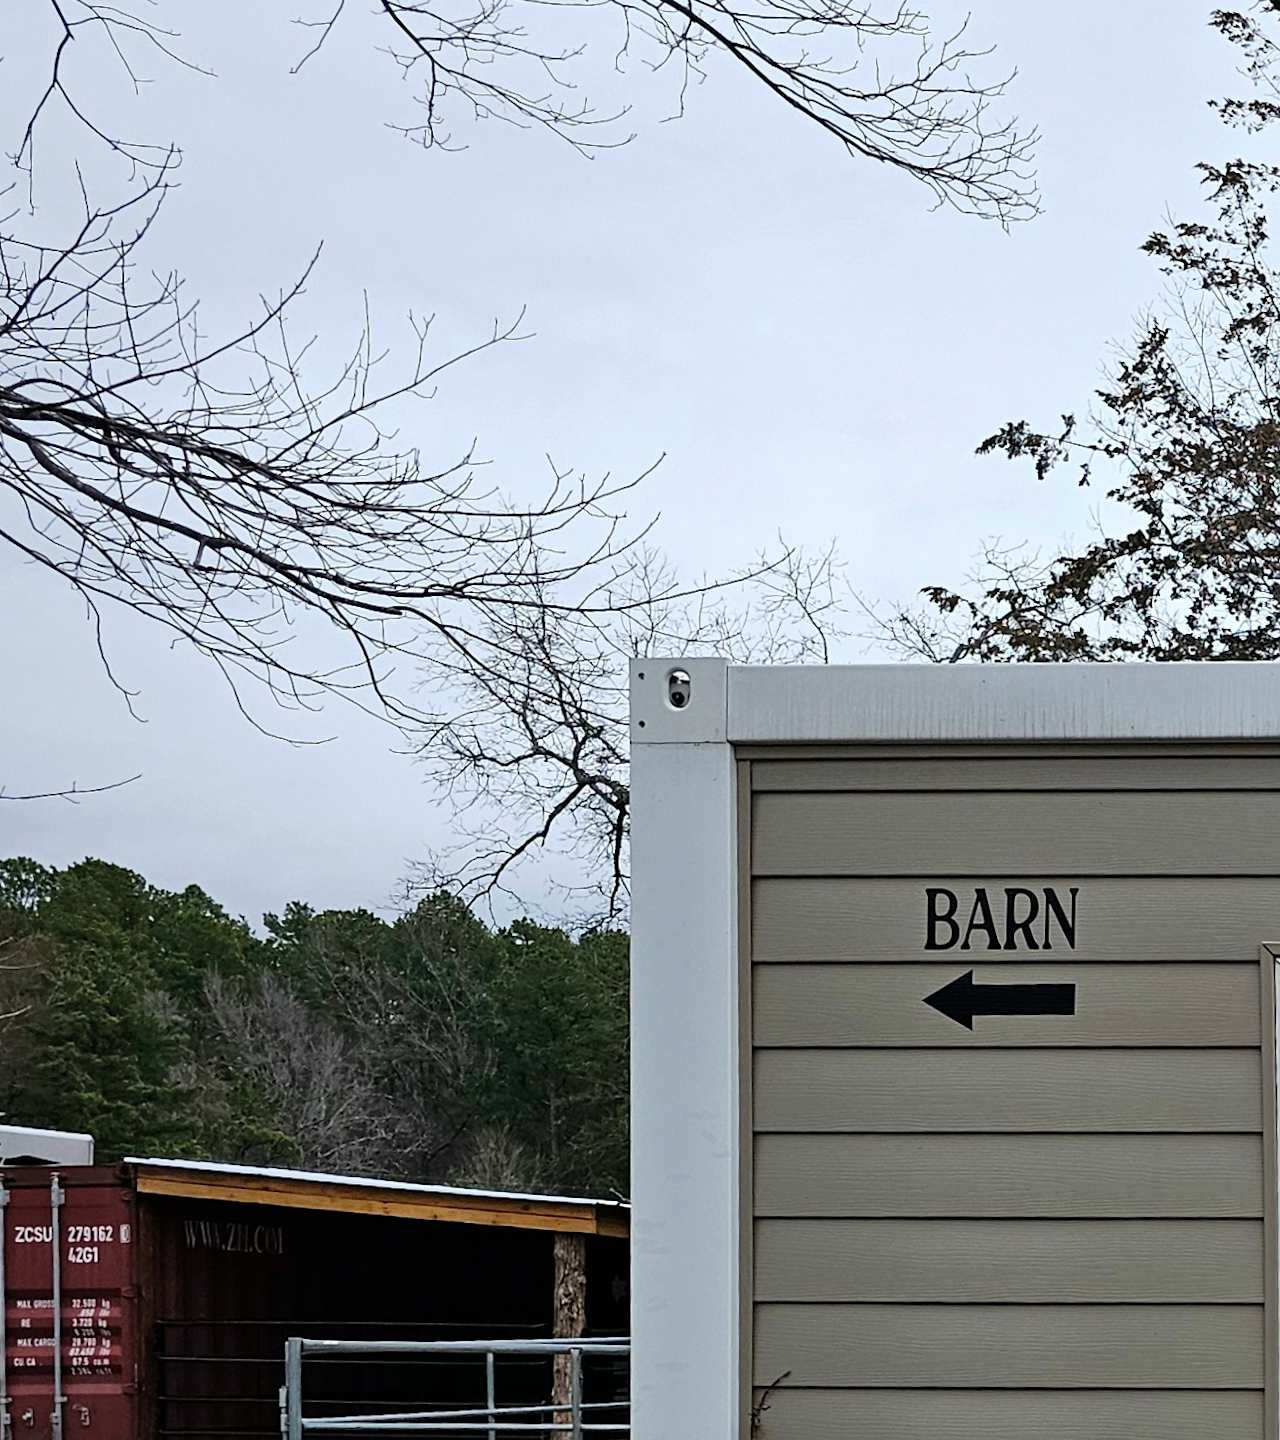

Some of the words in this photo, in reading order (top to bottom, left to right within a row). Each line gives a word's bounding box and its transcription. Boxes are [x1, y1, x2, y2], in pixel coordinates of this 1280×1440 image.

[924, 887, 1079, 950] BARN
[14, 1226, 53, 1242] ZCSU
[67, 1225, 114, 1242] 279162
[67, 1247, 98, 1263] 42G1
